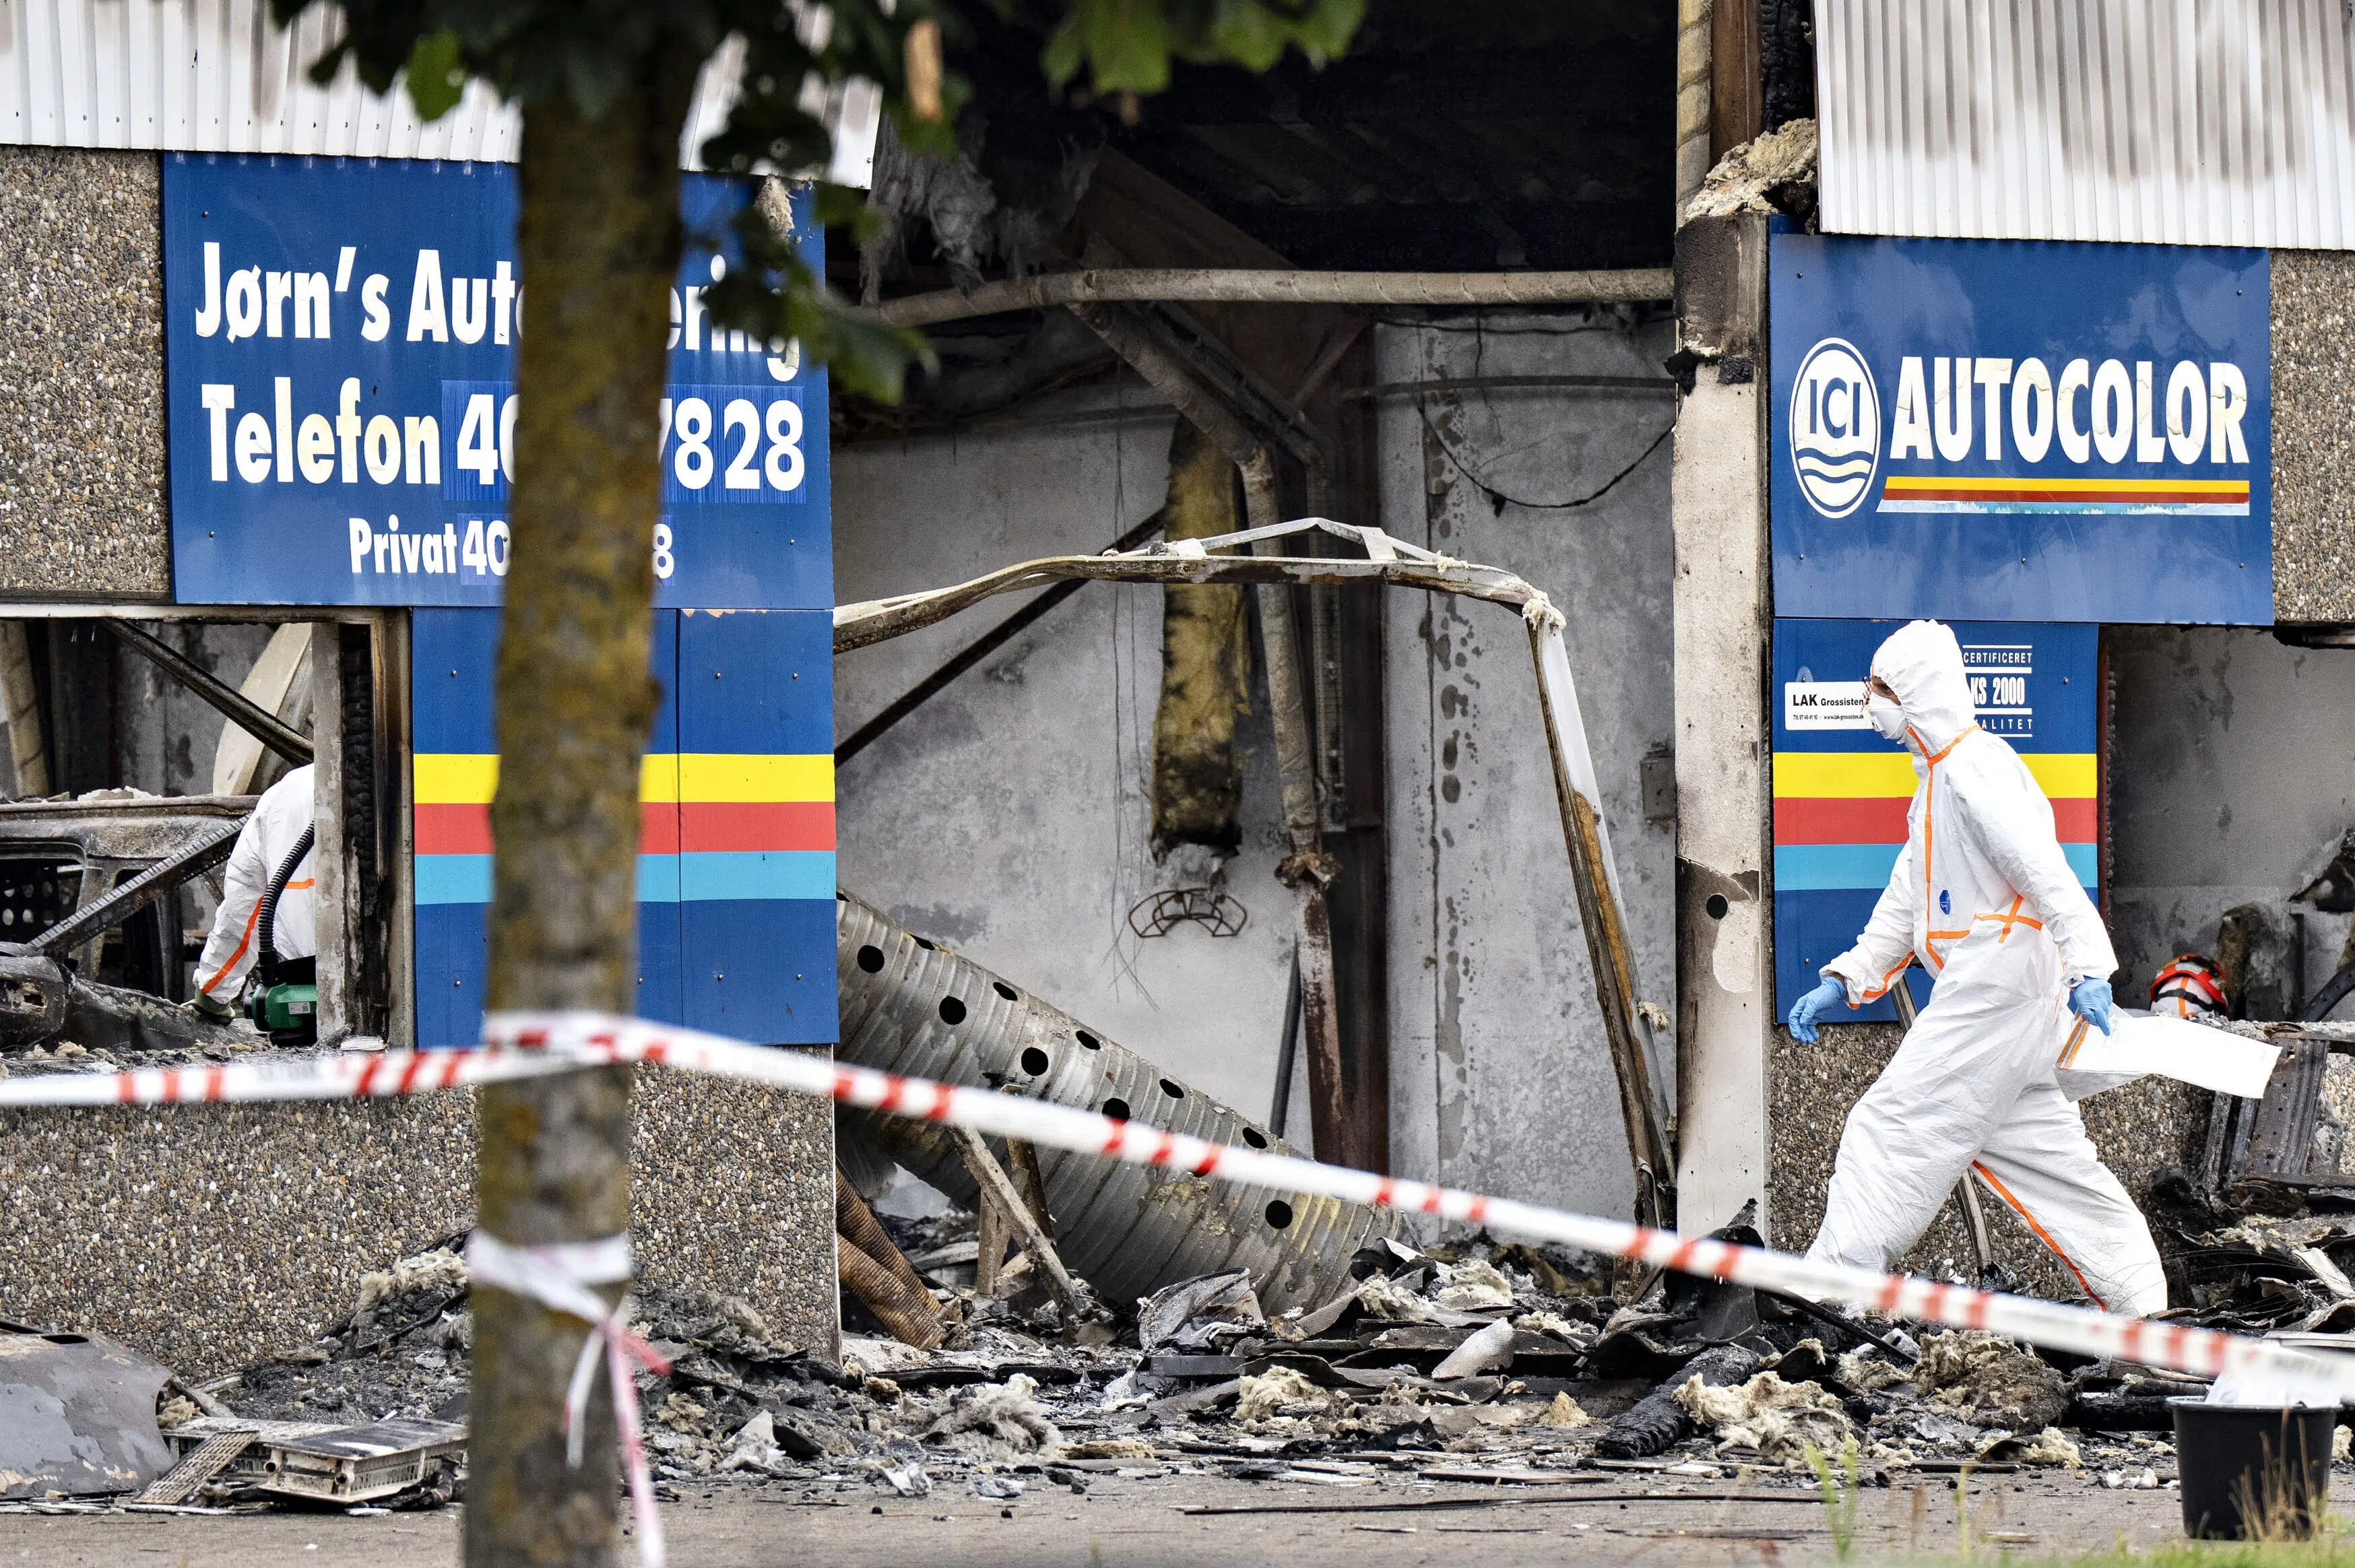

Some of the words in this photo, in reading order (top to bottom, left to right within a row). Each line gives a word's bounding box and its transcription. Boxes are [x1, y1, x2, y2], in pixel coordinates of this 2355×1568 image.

[1809, 378, 1861, 439] ICI
[1890, 356, 2250, 465] AUTOCOLOR
[201, 377, 441, 485] Telefon
[350, 514, 457, 574] Privat
[1963, 652, 2032, 663] CERTIFICERET
[1793, 694, 1818, 707] LAK
[1820, 698, 1864, 707] Grossisten
[1993, 676, 2025, 705] 2000
[1824, 713, 1864, 721] www.lak-grossisten.dk
[1976, 719, 2032, 730] ALITET
